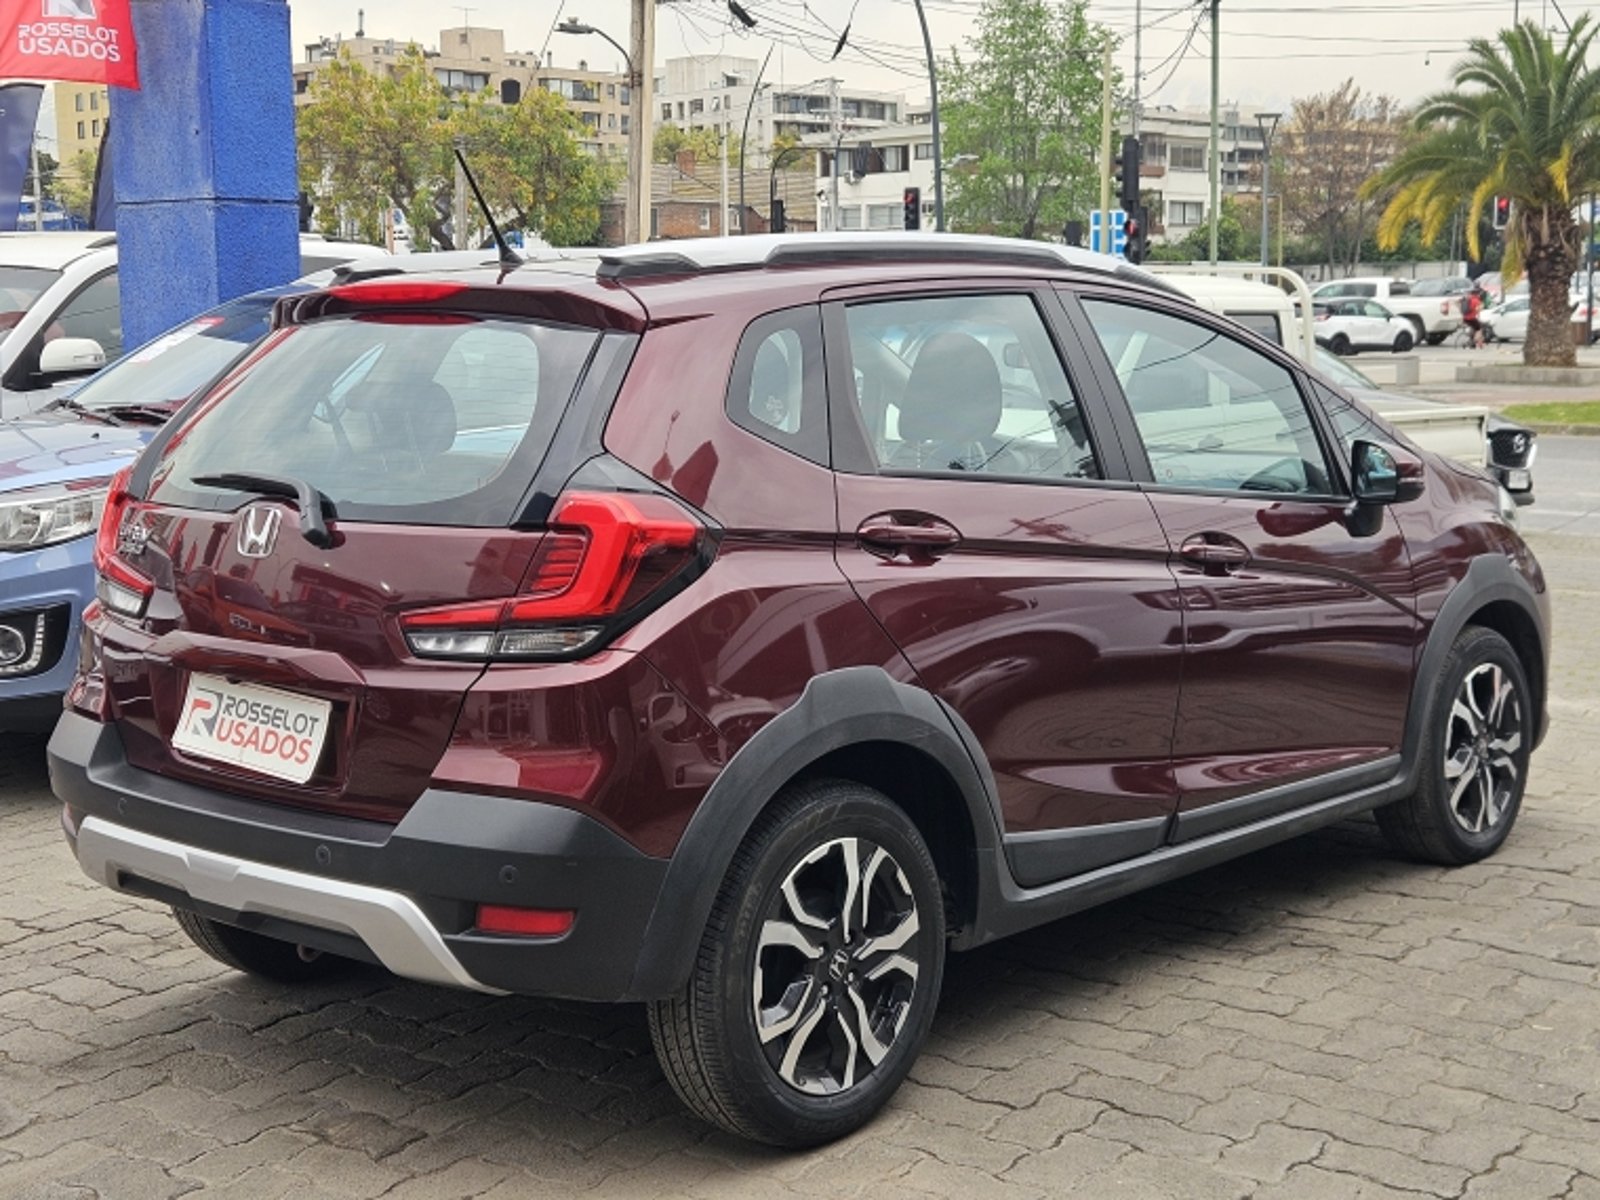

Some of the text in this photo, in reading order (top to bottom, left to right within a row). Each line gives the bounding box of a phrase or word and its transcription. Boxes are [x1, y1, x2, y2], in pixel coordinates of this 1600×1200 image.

[18, 22, 118, 42] ROSSELOT
[18, 37, 121, 62] USADOS
[222, 695, 319, 737] ROSSELOT
[216, 717, 312, 765] USADOS
